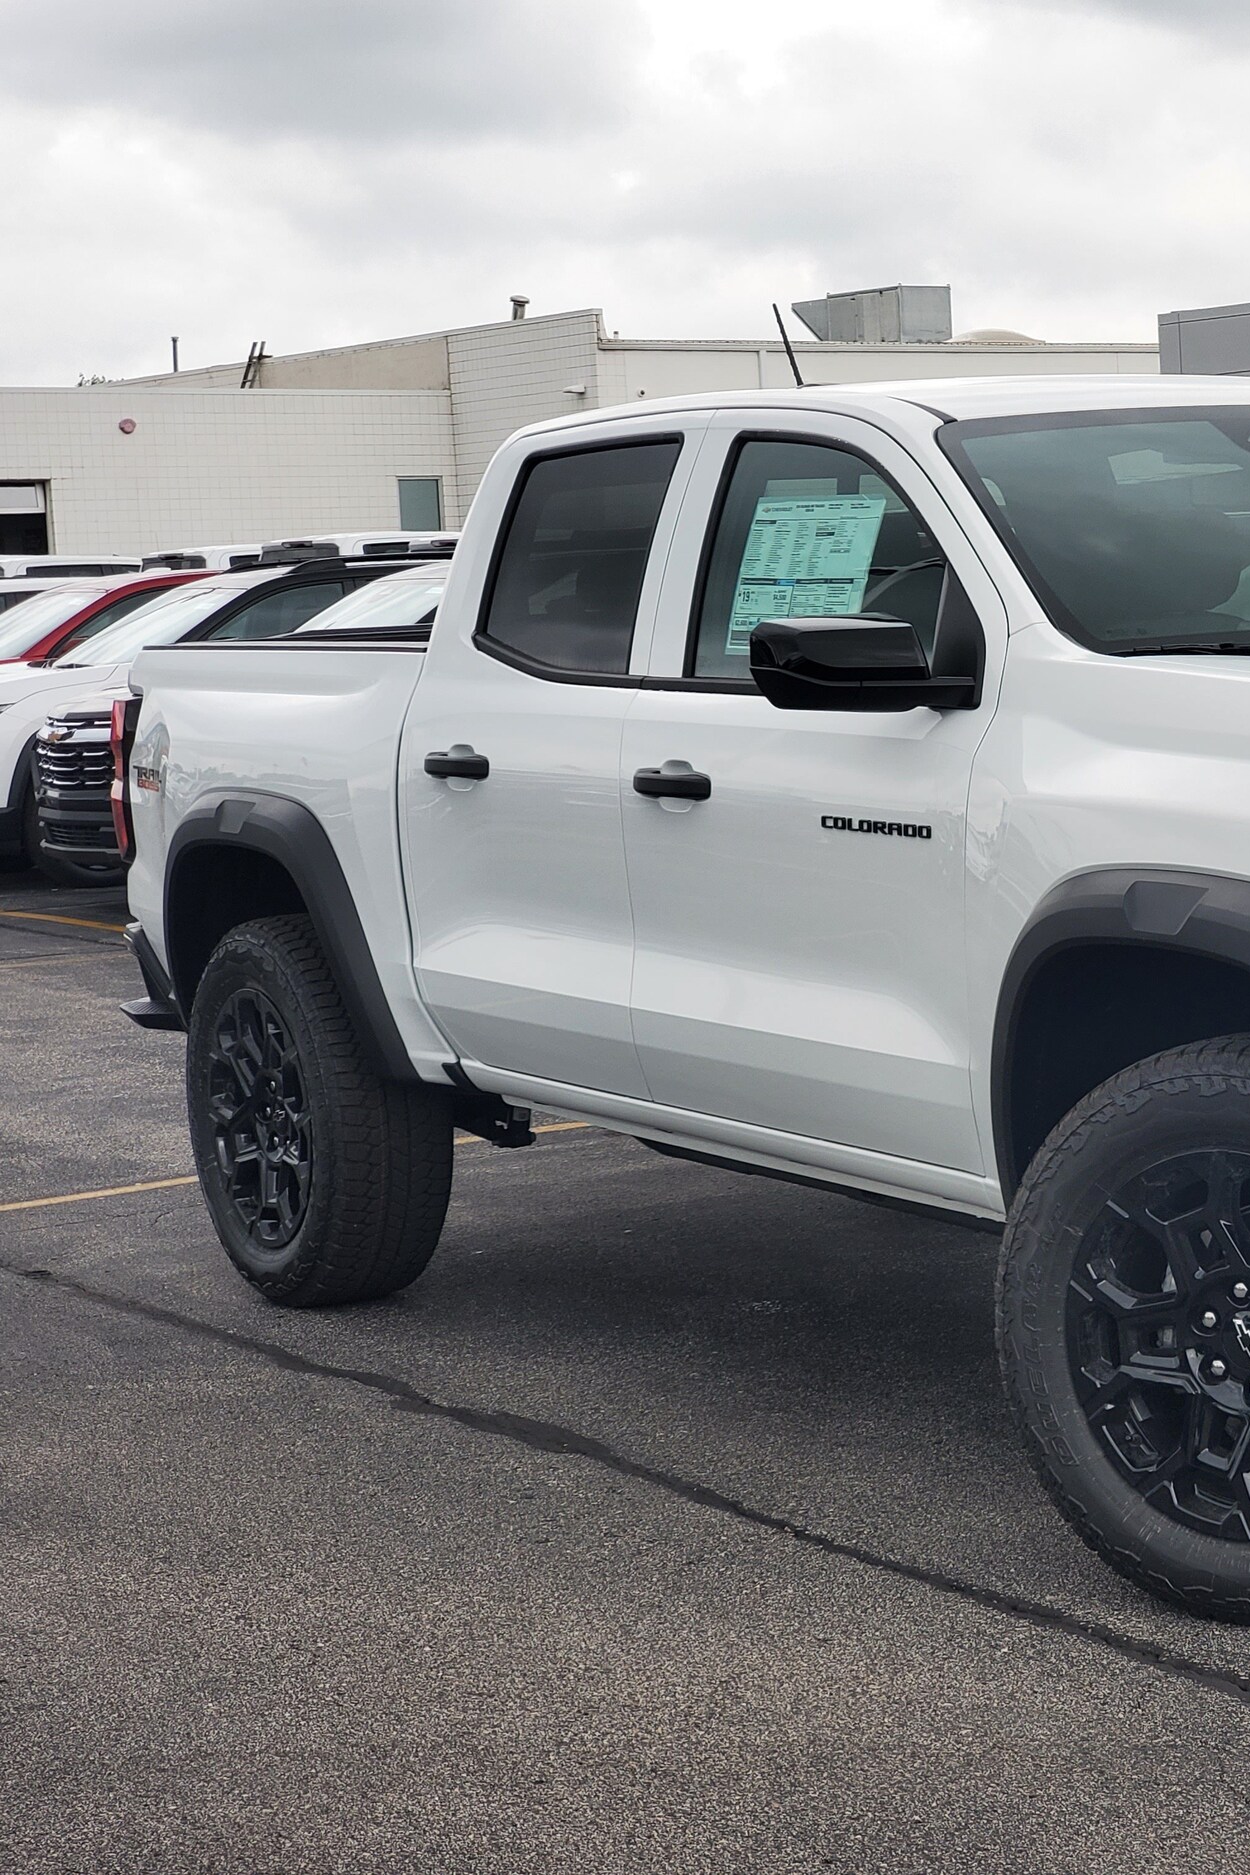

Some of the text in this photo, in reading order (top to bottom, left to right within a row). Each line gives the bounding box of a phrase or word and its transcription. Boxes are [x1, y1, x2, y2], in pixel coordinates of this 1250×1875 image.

[742, 591, 751, 602] 19
[132, 765, 162, 783] TRAIL
[137, 778, 160, 792] BOSS
[821, 815, 932, 839] COLORADO
